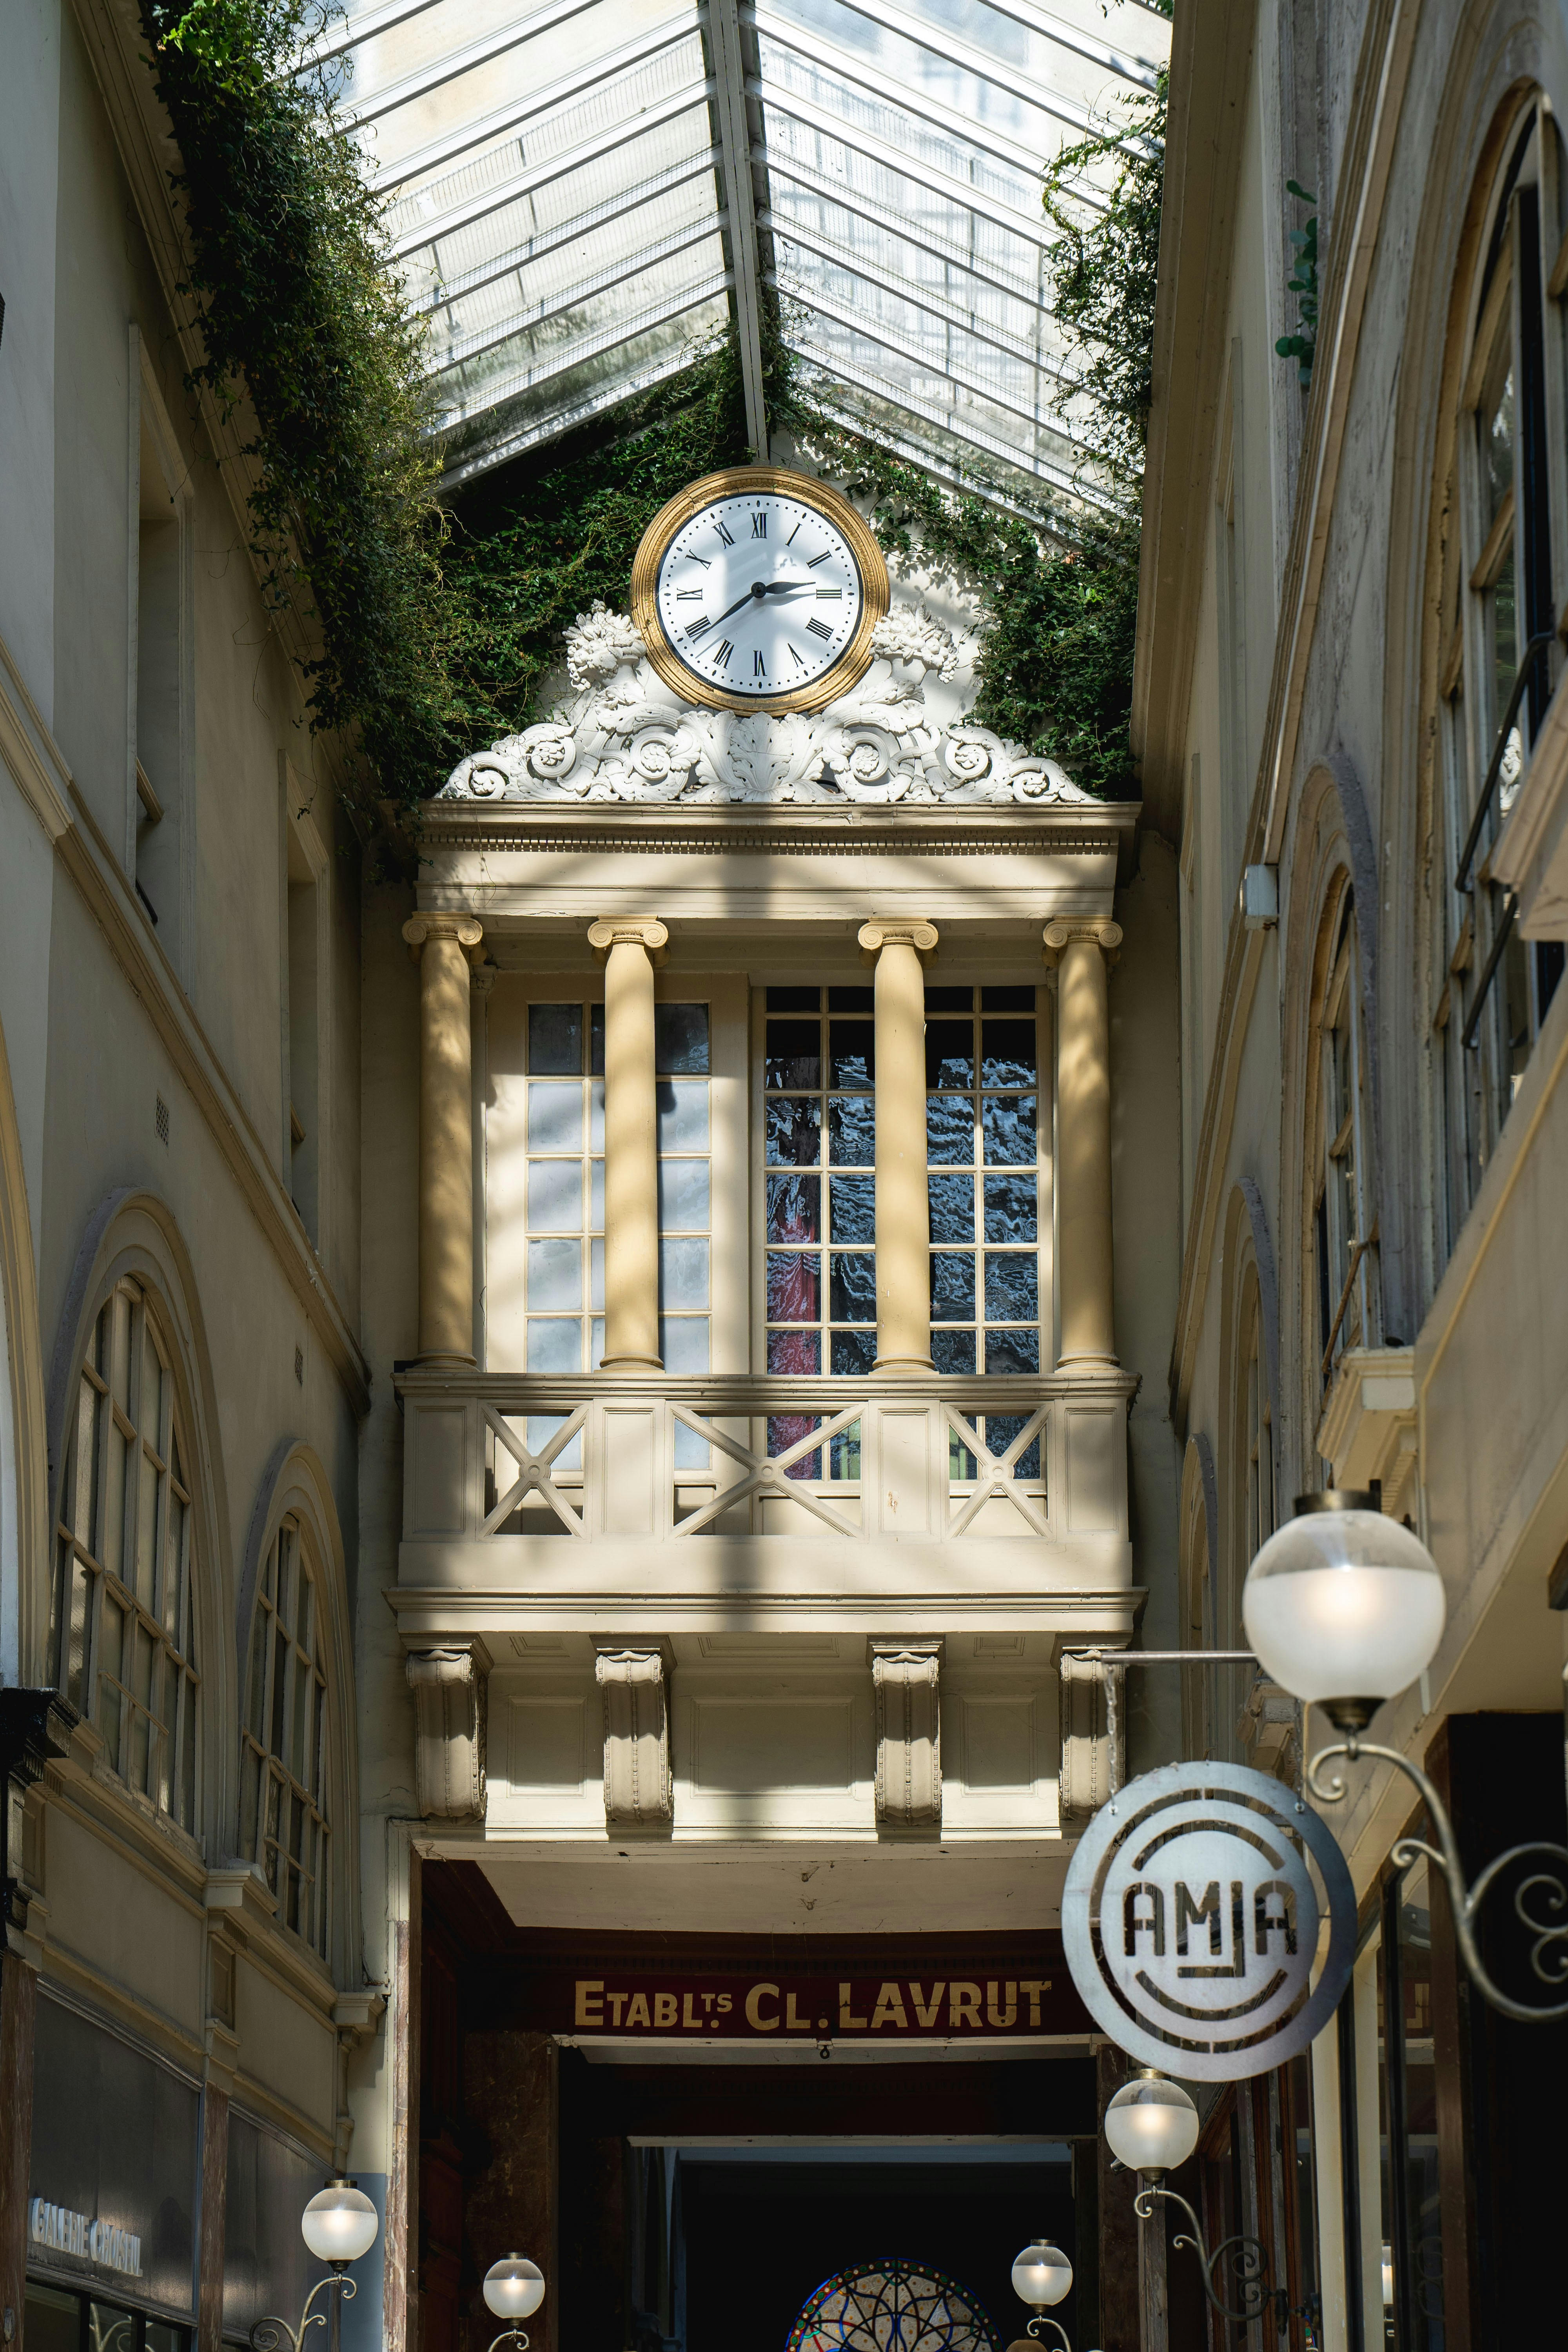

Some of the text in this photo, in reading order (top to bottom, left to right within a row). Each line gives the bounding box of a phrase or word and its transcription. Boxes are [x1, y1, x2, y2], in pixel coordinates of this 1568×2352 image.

[712, 521, 735, 549] XI
[751, 512, 768, 539] XII
[685, 549, 712, 570] X
[806, 550, 832, 569] II
[677, 588, 702, 601] IX
[816, 588, 842, 600] III
[712, 639, 735, 669] VII
[753, 650, 767, 676] VI
[788, 642, 805, 667] V
[839, 1980, 1052, 2028] LAVRUT
[32, 2198, 89, 2258] GALERIE
